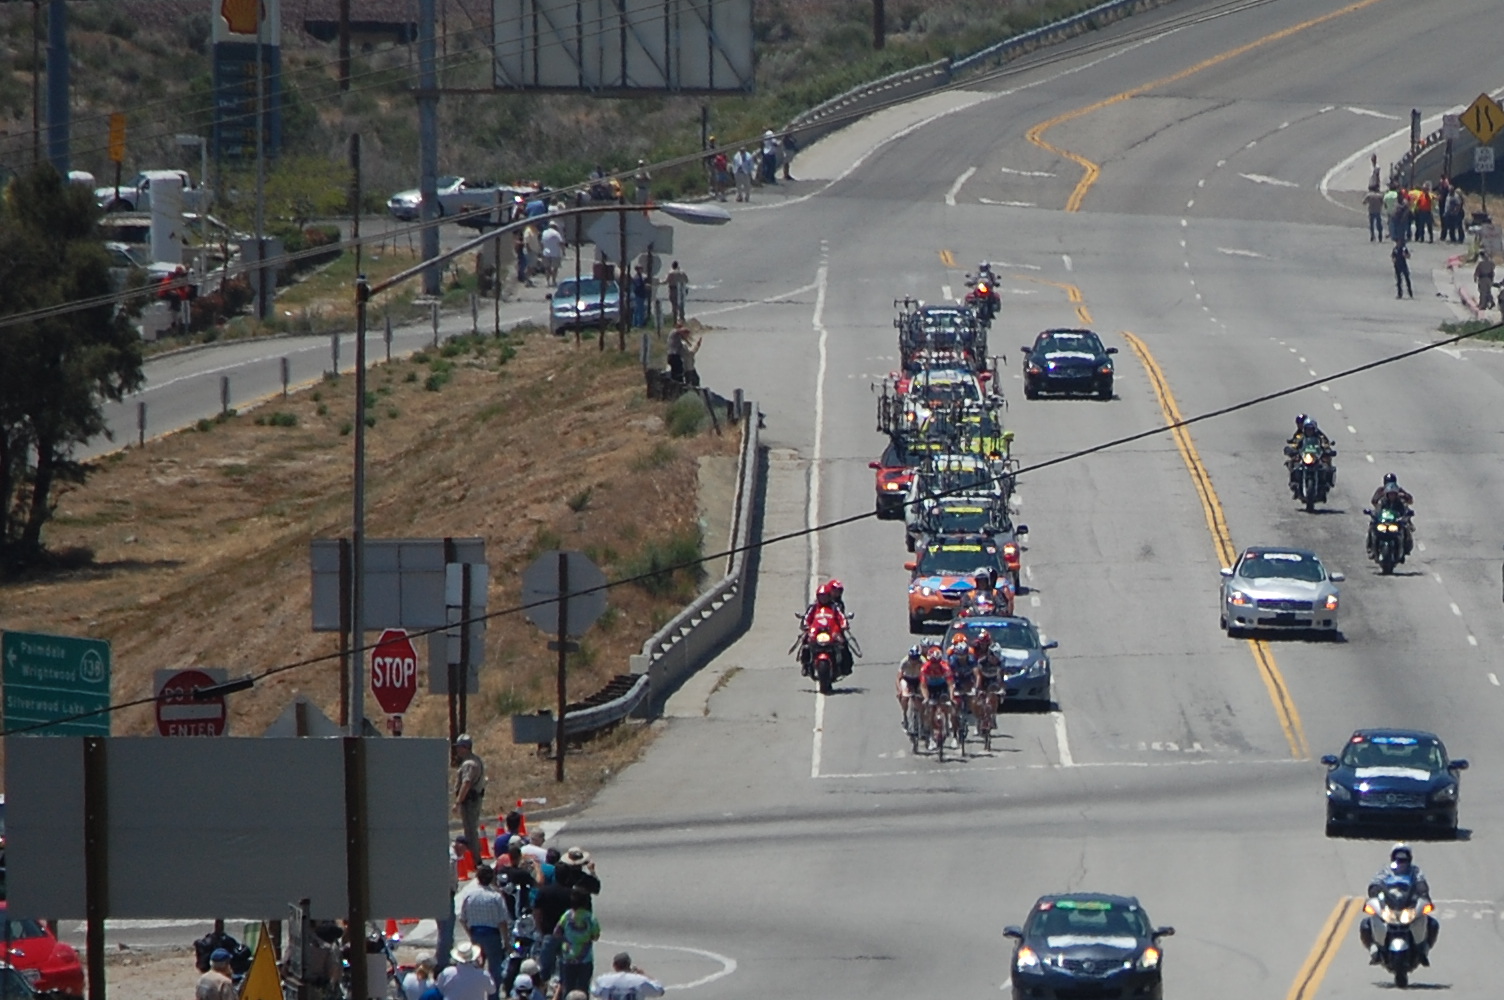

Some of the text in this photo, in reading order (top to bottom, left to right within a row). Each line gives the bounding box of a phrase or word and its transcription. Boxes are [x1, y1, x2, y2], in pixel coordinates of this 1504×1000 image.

[20, 641, 66, 659] Palmdale
[21, 664, 76, 682] Wrightwood
[83, 659, 102, 677] 138
[373, 656, 415, 688] STOP
[7, 695, 85, 714] Silverwood Lake
[169, 722, 215, 737] ENTER
